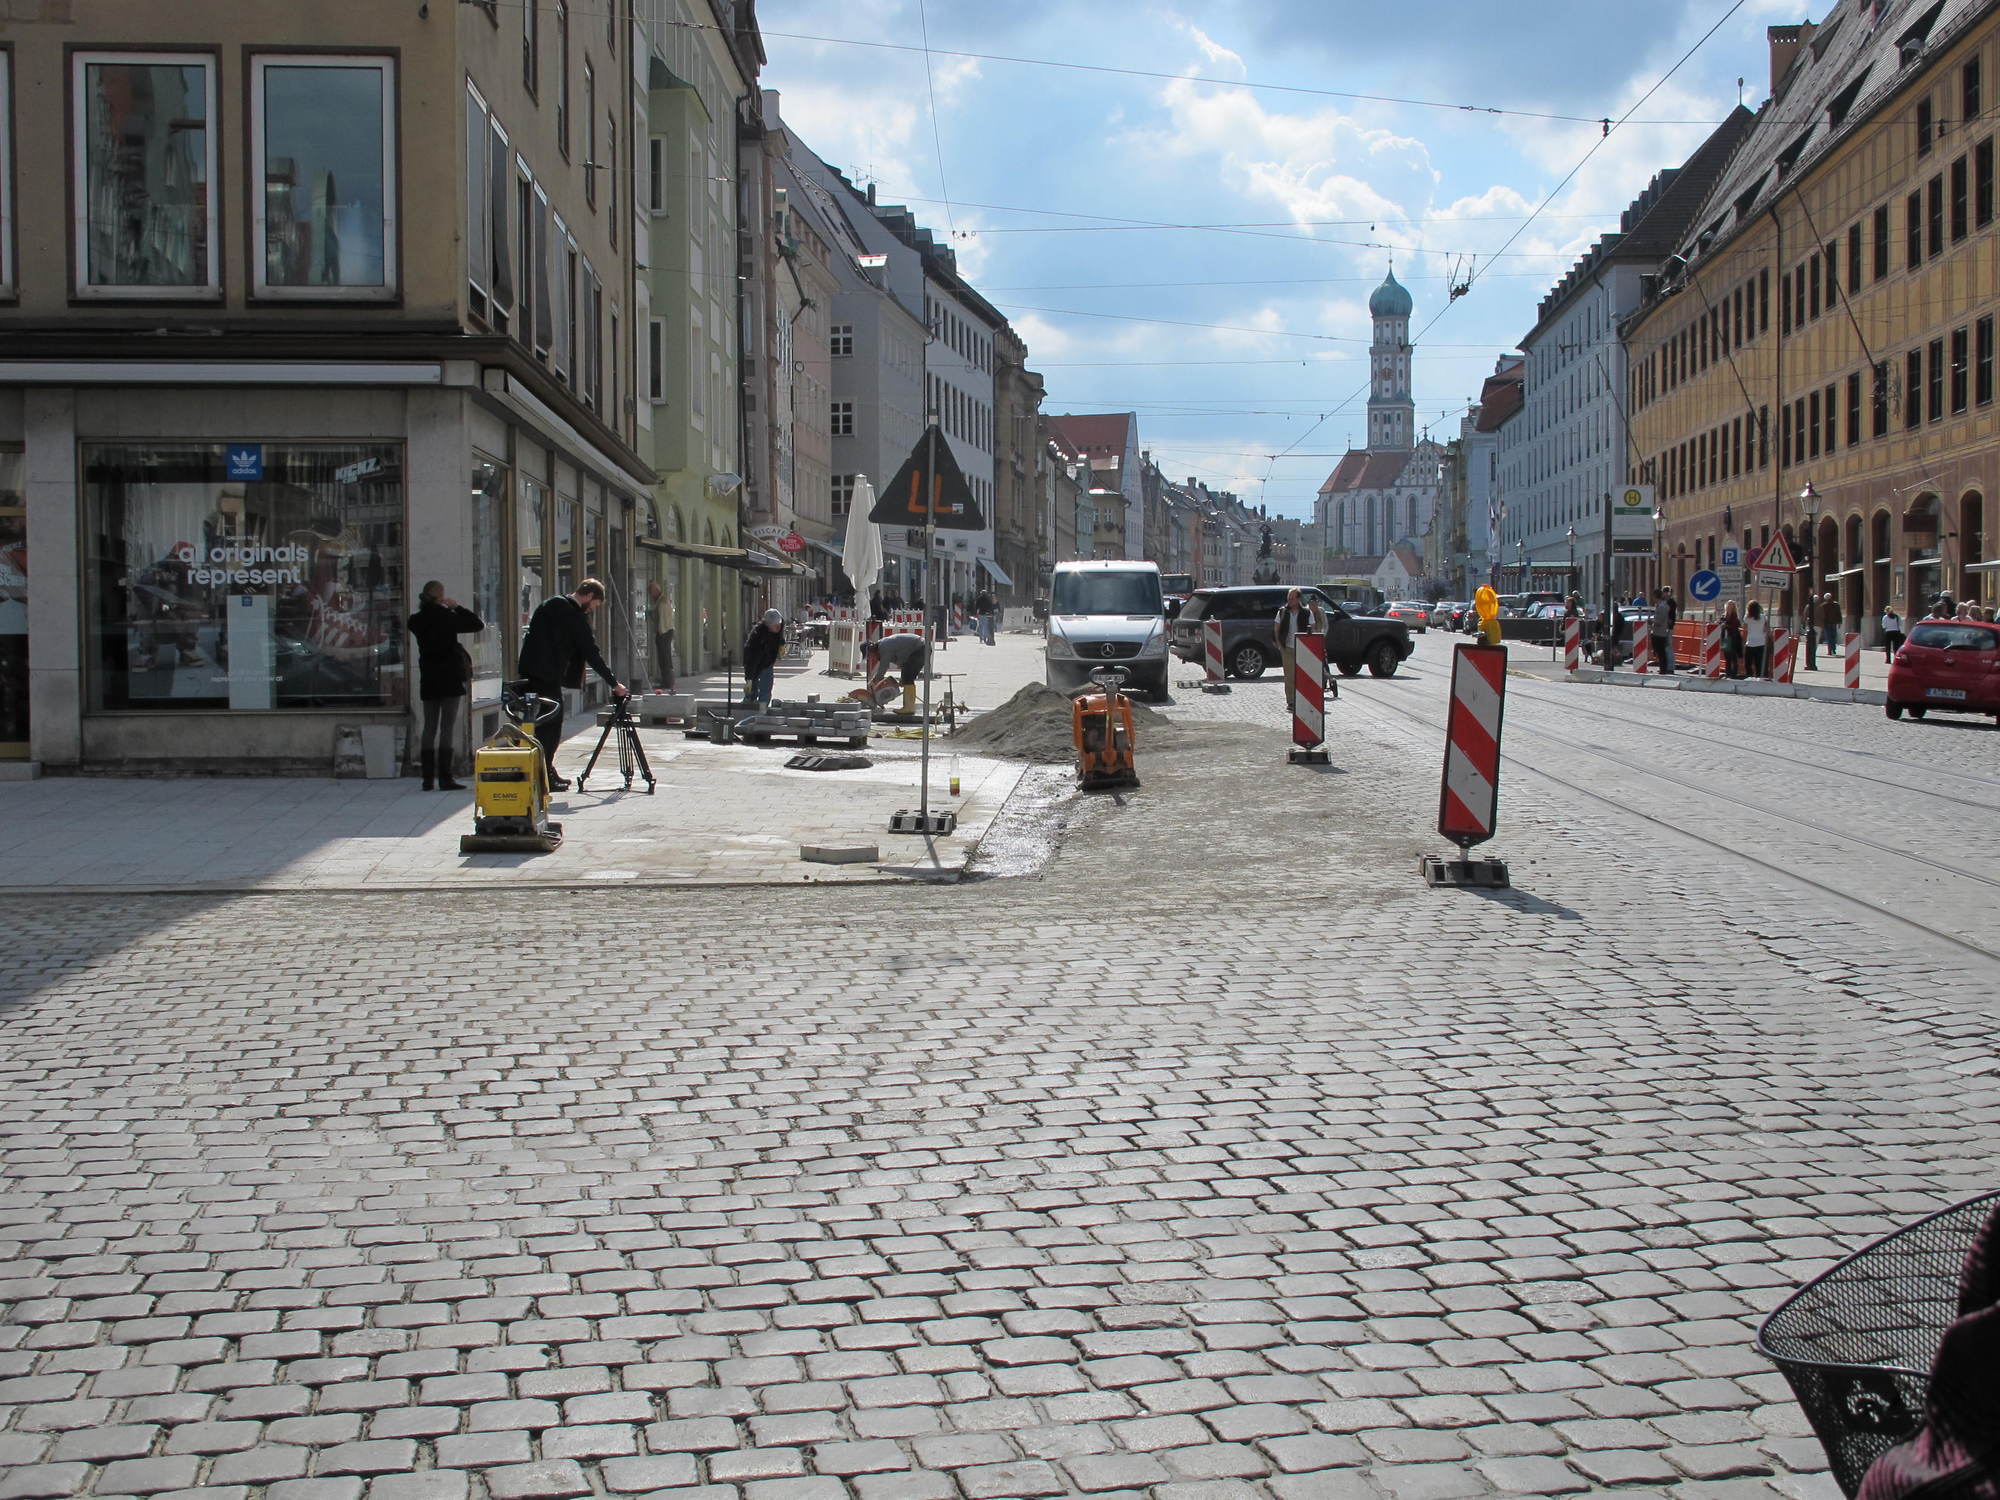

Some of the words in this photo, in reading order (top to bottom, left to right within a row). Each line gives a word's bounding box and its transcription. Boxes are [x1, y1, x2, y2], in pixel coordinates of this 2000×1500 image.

[210, 543, 309, 566] originals
[1725, 551, 1735, 563] P
[188, 568, 301, 588] represent
